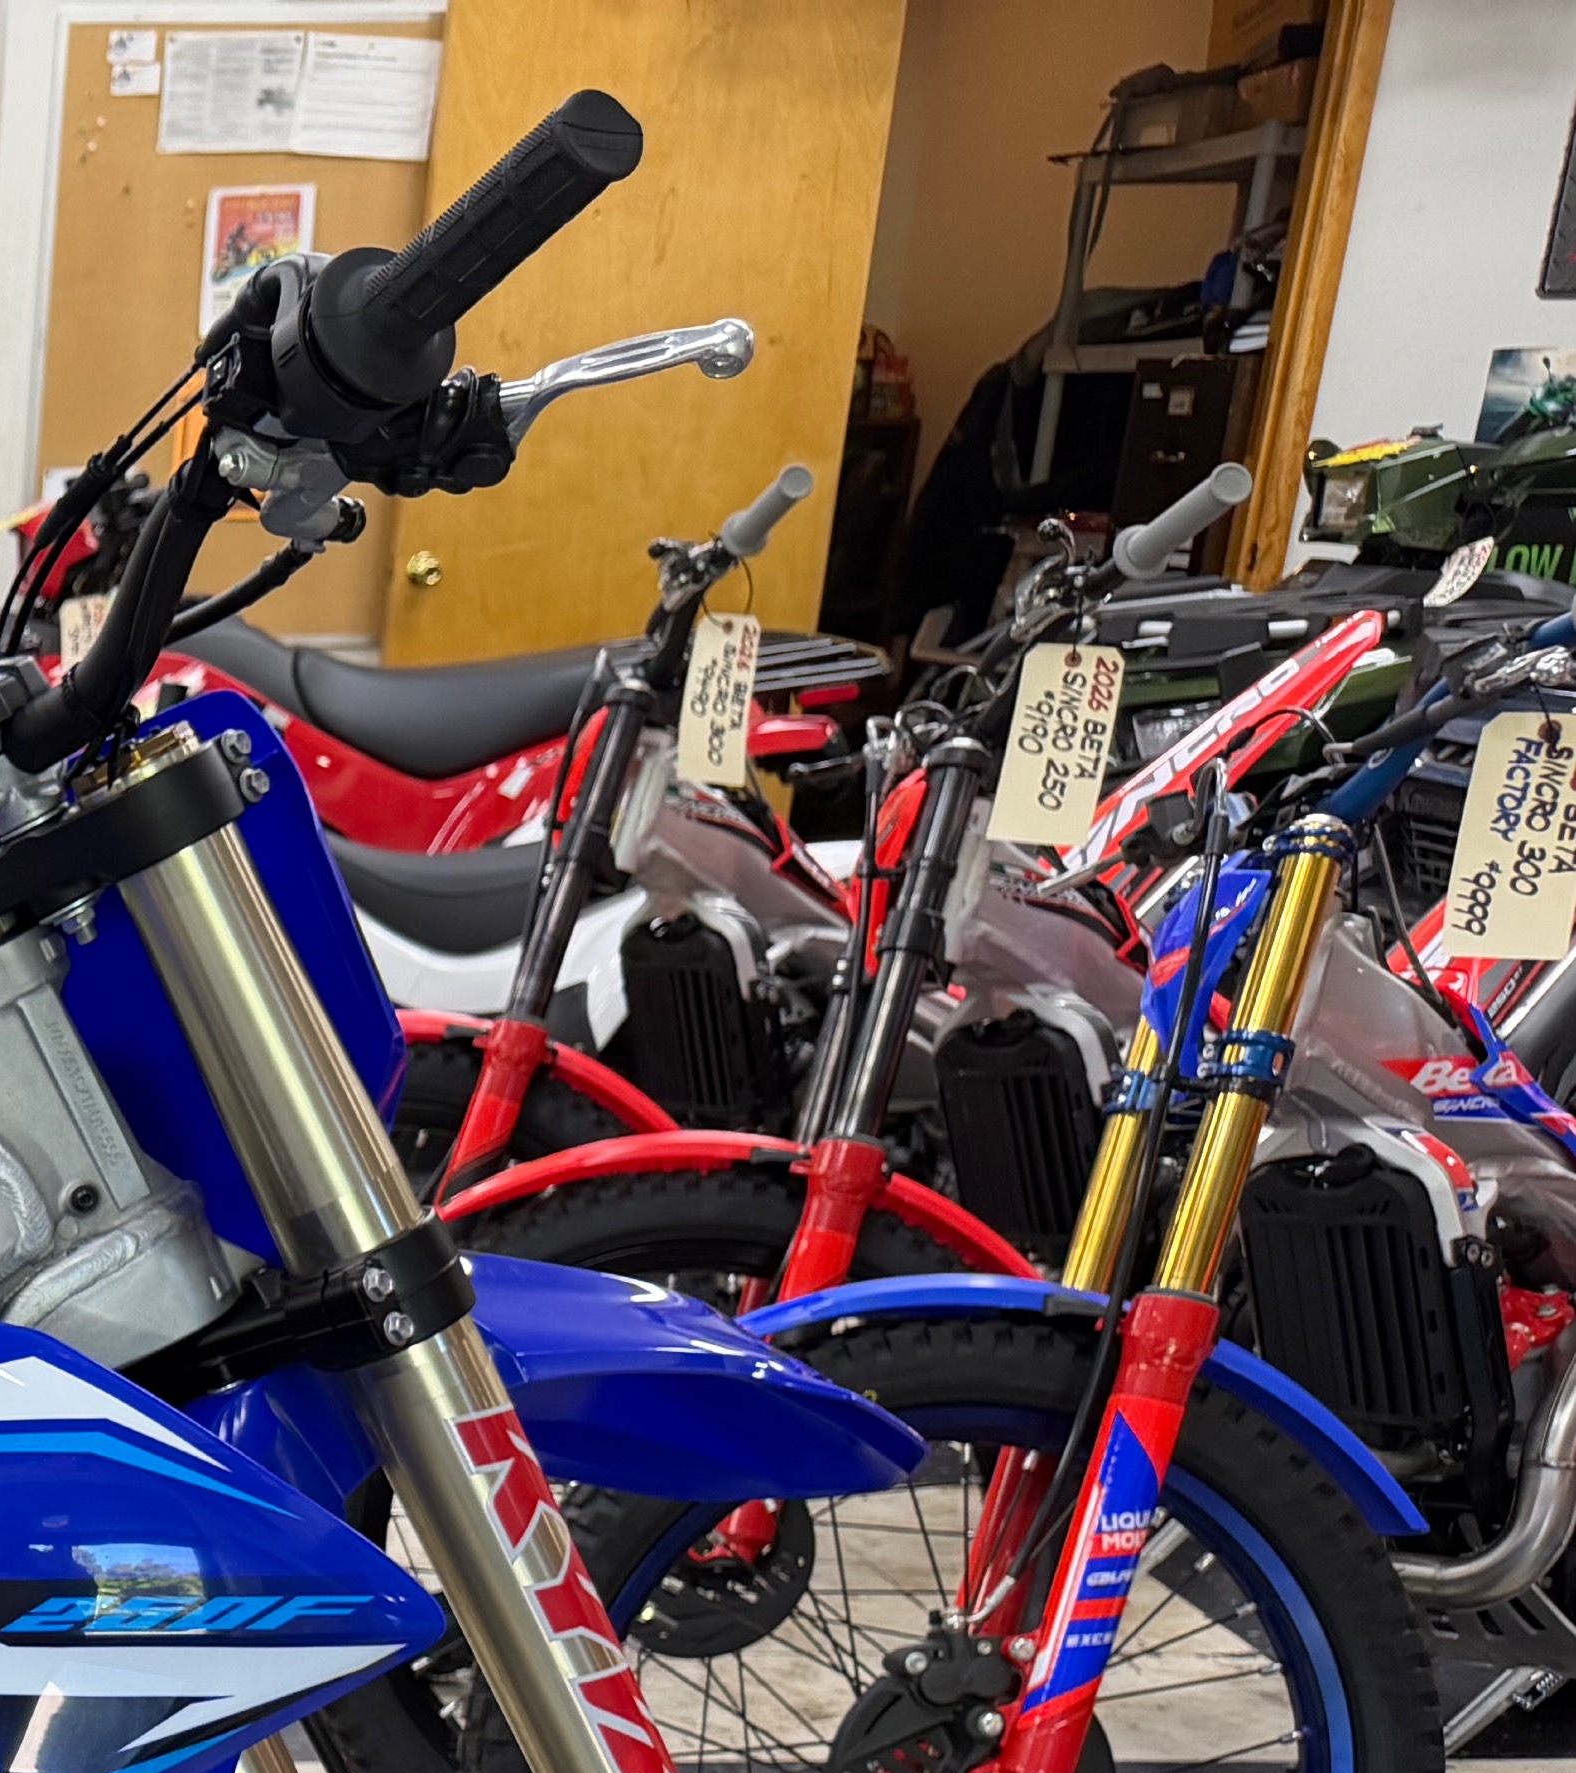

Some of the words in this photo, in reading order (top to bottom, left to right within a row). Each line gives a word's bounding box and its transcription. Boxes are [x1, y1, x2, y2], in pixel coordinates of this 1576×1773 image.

[1051, 669, 1088, 752] SINCRO
[1087, 655, 1121, 714] 2026
[1073, 718, 1108, 780] BETA
[1037, 757, 1070, 813] 250
[1489, 736, 1544, 843] FACTORY
[1523, 744, 1575, 834] SINCRO
[1508, 839, 1548, 897] 300
[0, 1594, 376, 1634] 250F
